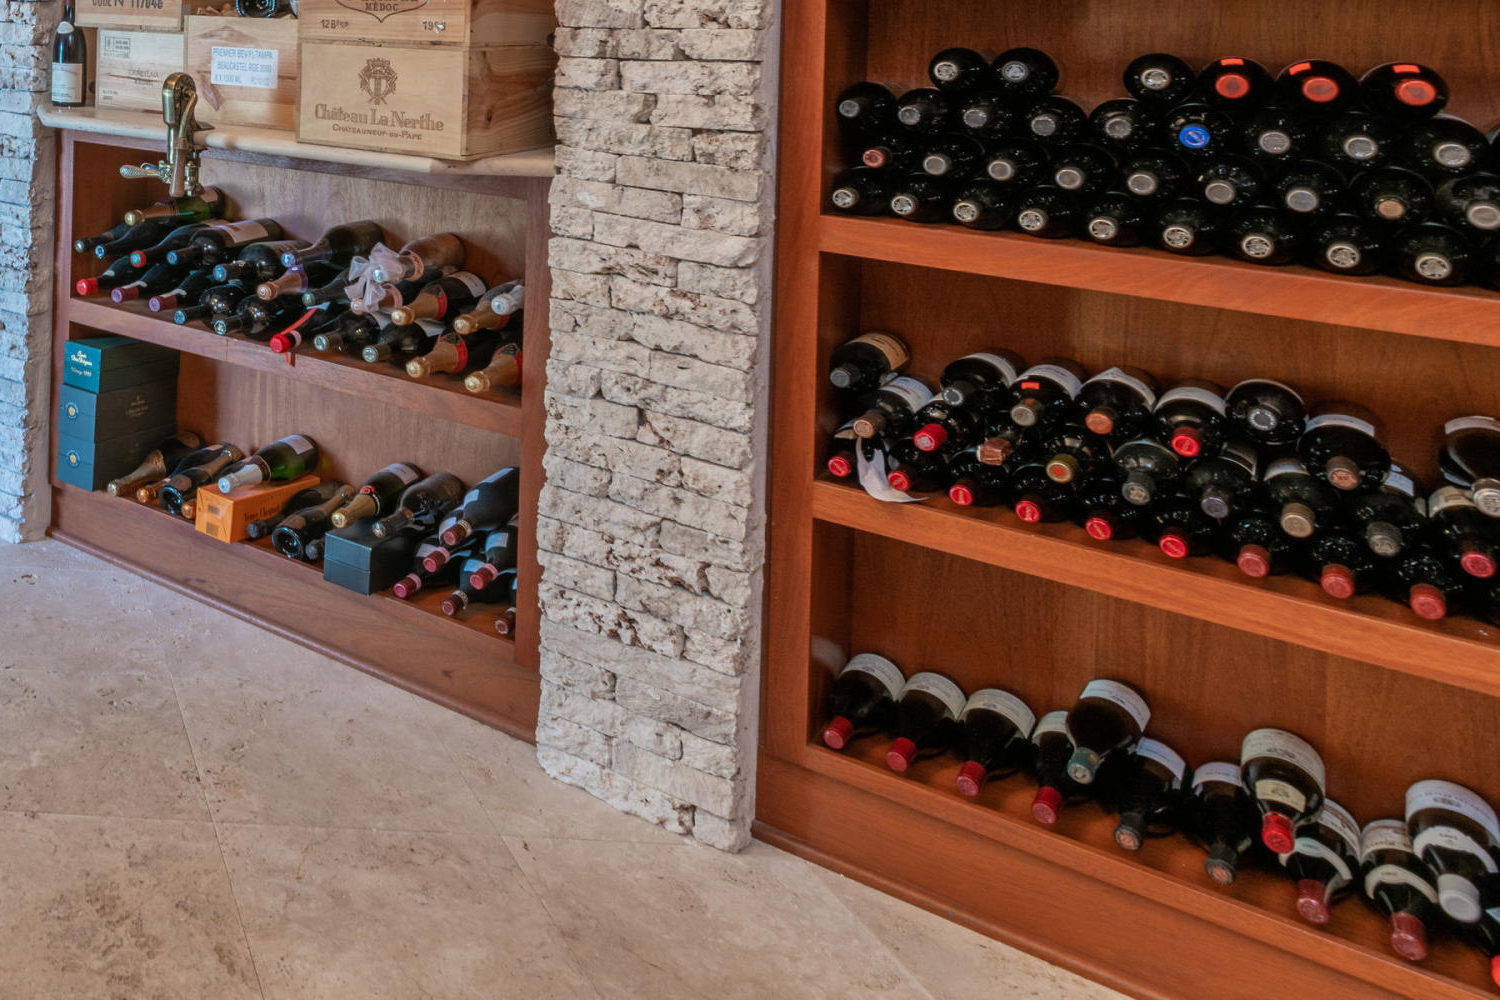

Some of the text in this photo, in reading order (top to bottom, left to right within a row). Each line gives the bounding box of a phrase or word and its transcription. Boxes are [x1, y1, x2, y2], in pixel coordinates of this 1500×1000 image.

[315, 103, 444, 131] Château La Nerthe
